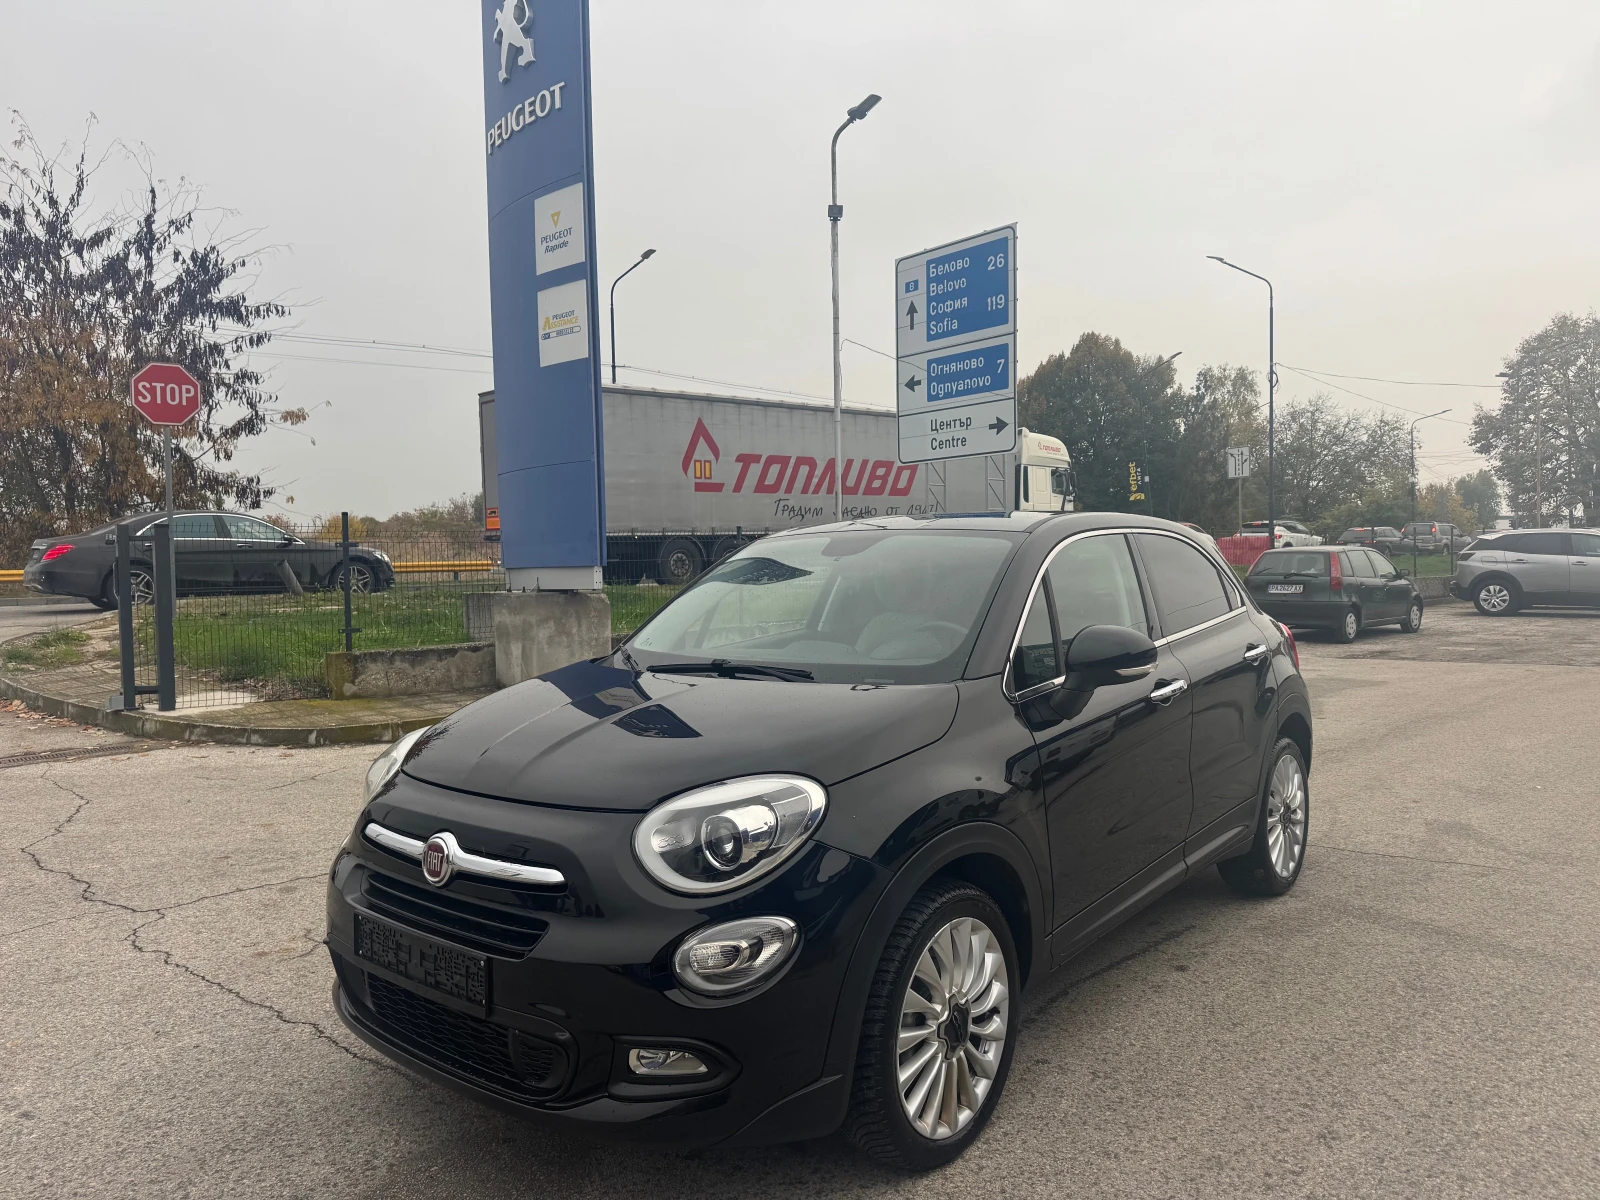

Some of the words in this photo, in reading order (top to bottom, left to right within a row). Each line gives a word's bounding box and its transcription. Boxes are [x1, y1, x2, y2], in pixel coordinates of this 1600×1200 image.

[487, 81, 566, 155] PEUGEOT
[540, 227, 573, 245] PEUGEOT
[544, 240, 569, 254] Rapide
[929, 257, 970, 278] Белово
[987, 253, 1005, 271] 26
[929, 278, 967, 296] Belovo
[929, 297, 968, 315] София
[987, 294, 1005, 311] 119
[552, 310, 575, 320] PEUGEOT
[929, 318, 958, 335] Sofia
[930, 357, 984, 376] Огняново
[996, 359, 1005, 374] 7
[137, 381, 195, 406] STOP
[930, 375, 991, 397] Ognyanovo
[930, 416, 972, 433] Център
[930, 435, 967, 450] Centre
[731, 453, 919, 497] ТОПЛИВО
[1128, 461, 1137, 491] efbet
[427, 850, 443, 872] FIAT
